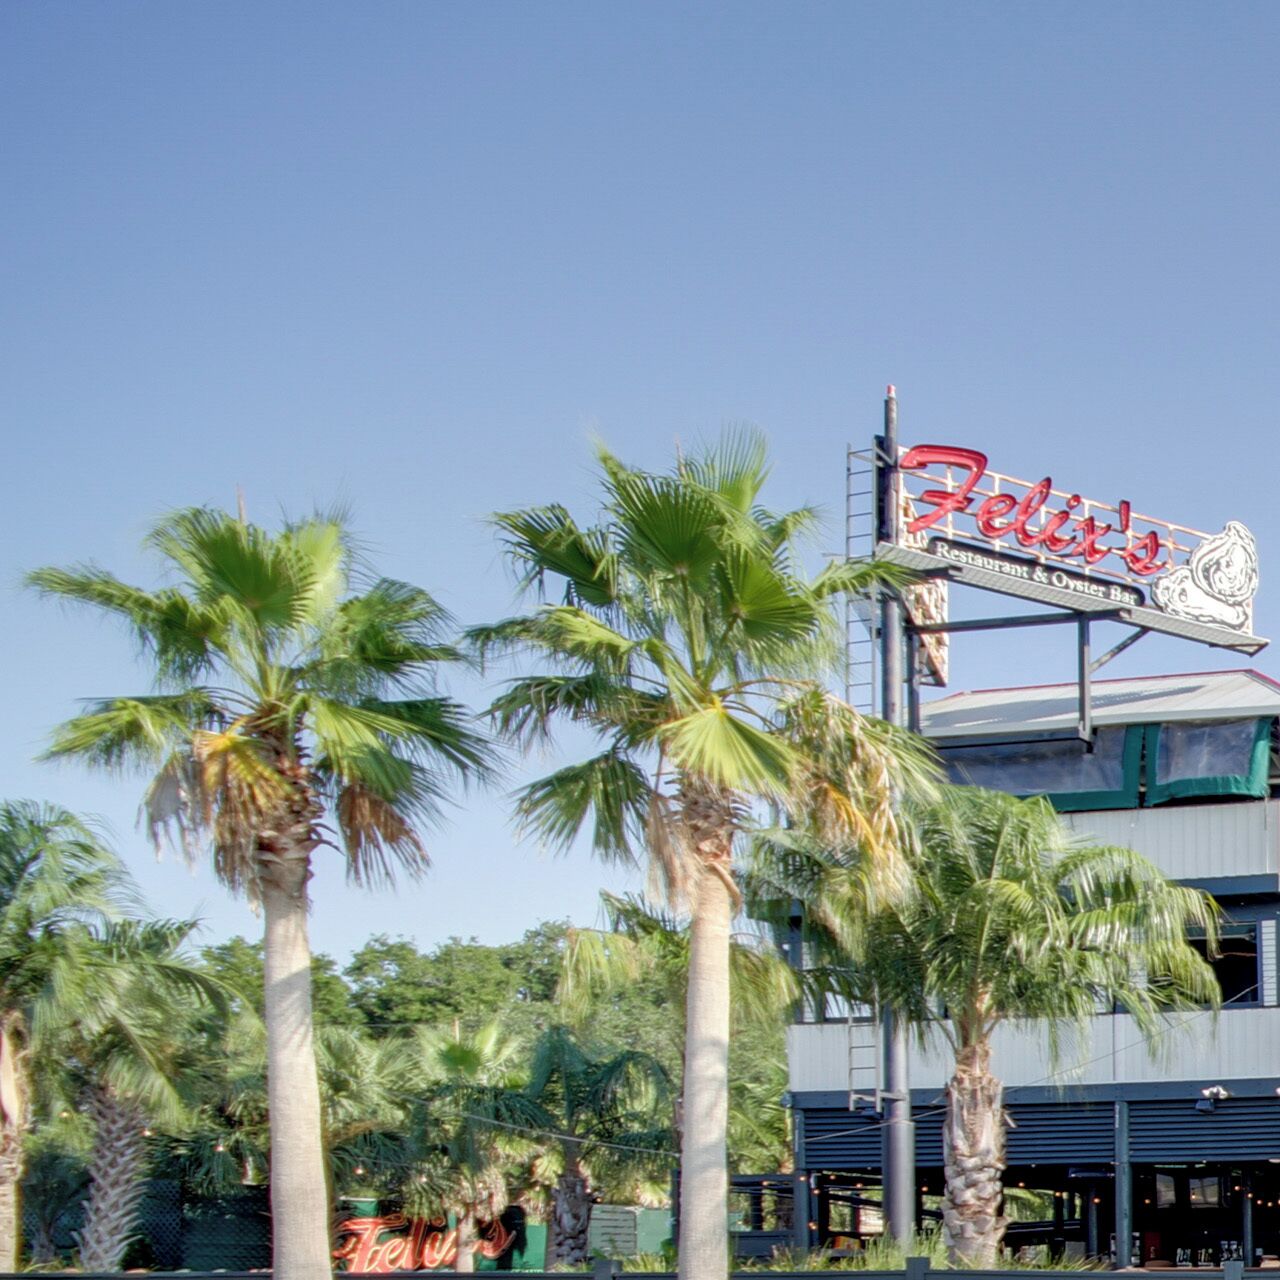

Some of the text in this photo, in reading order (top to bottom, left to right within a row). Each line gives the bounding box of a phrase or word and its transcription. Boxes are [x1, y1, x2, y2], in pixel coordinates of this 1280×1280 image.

[900, 444, 1167, 576] Felix's
[935, 540, 1138, 605] Restaurant & Oyster Bar
